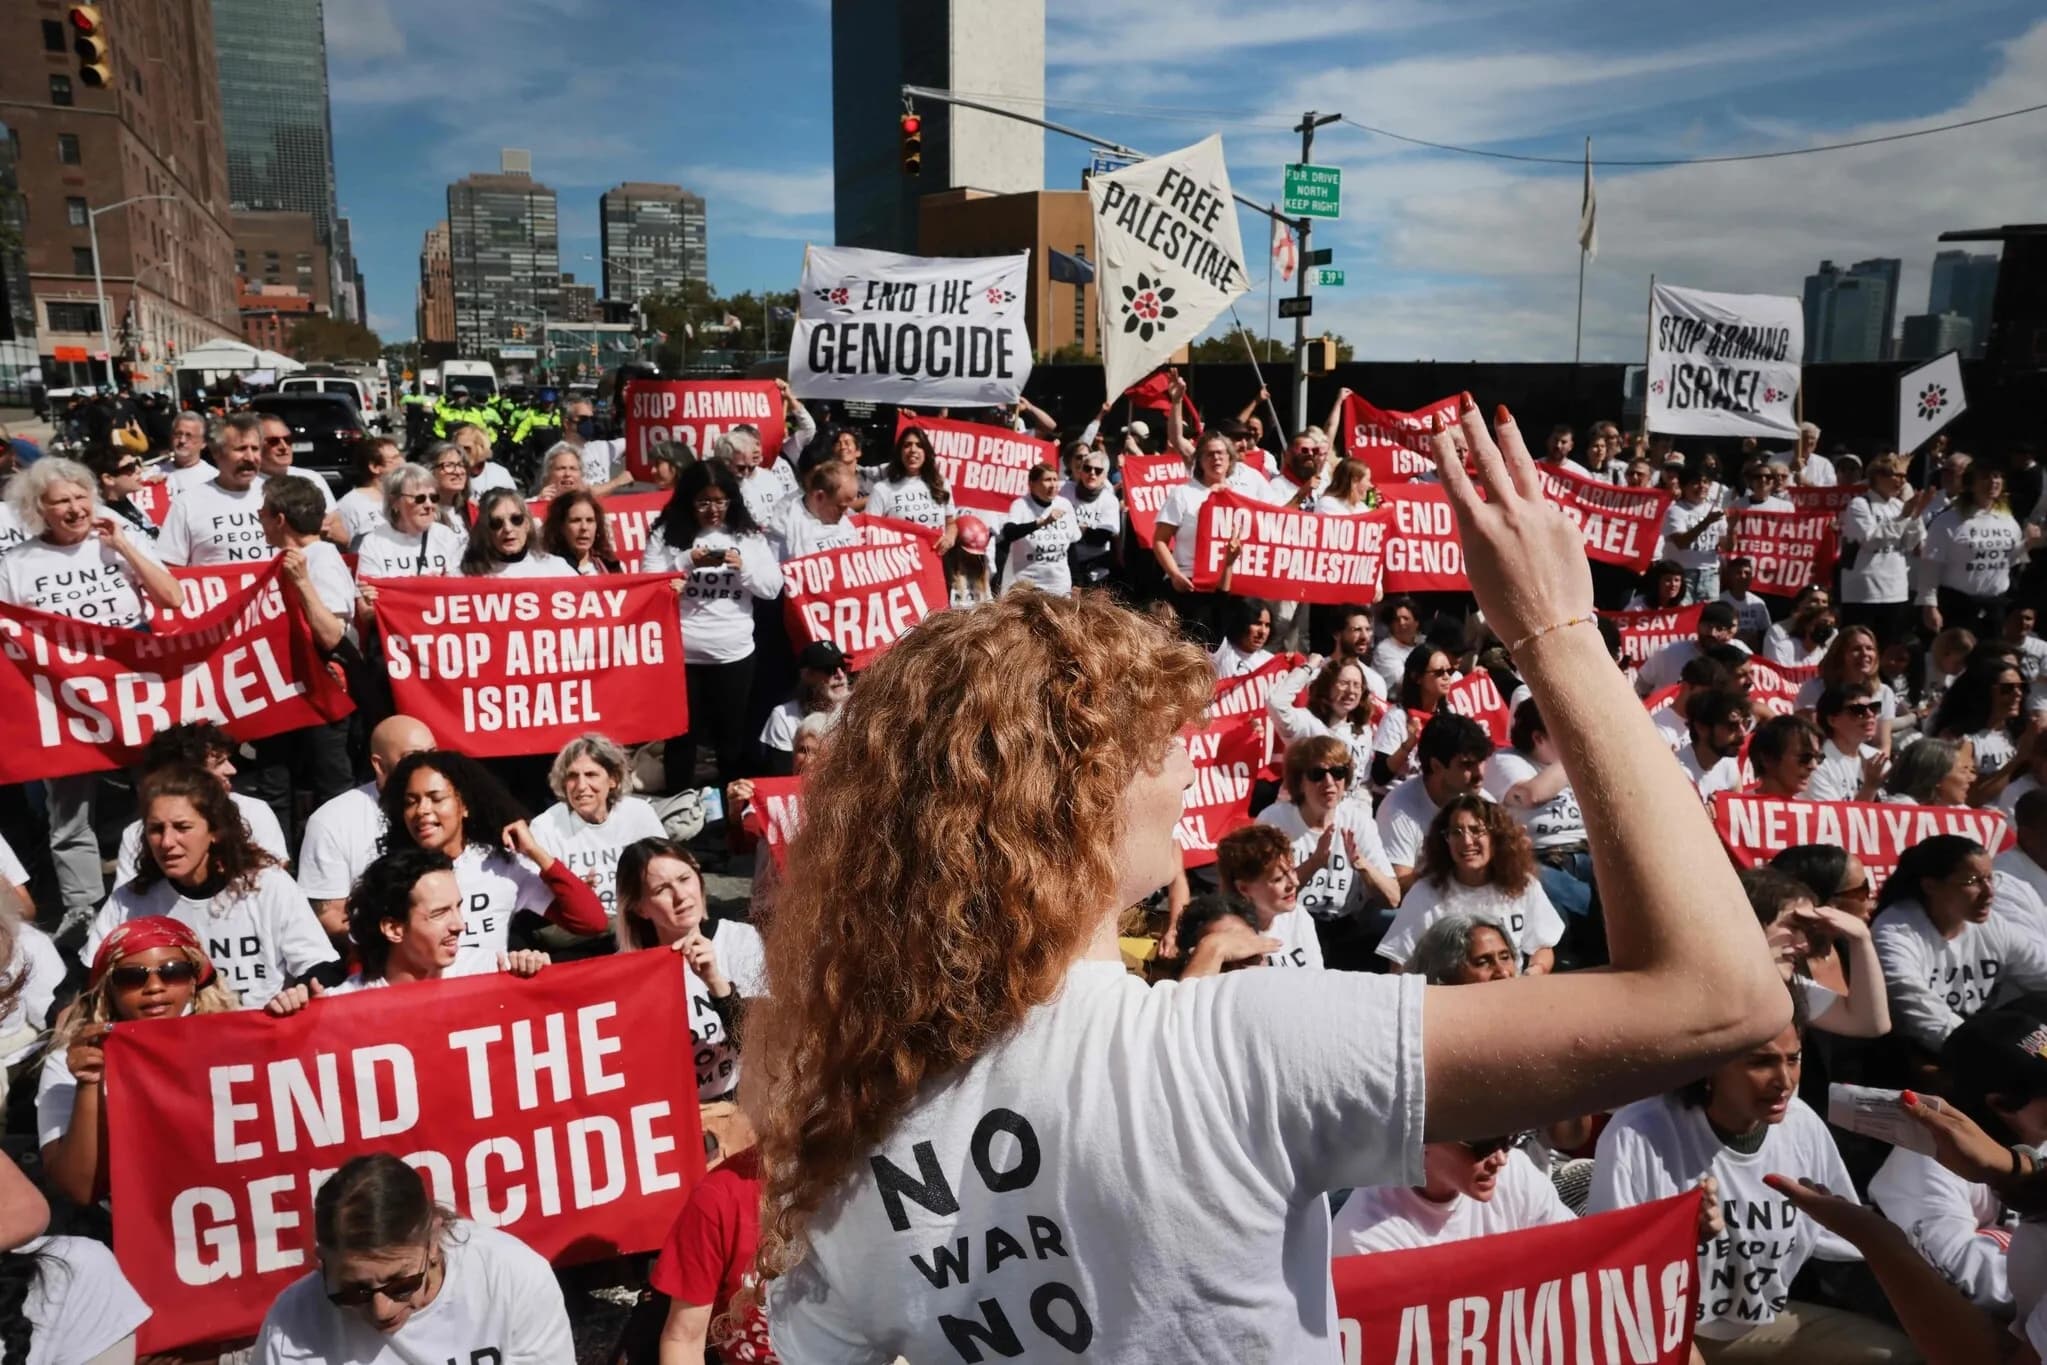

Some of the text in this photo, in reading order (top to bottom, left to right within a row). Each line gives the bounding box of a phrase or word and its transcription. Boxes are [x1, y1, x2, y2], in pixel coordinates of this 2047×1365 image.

[1297, 186, 1328, 198] NORTH
[1311, 172, 1338, 184] DRIVE
[1156, 167, 1225, 233] FREE
[1285, 198, 1338, 212] KEEP RIGHT
[1099, 180, 1240, 295] PALESTINE
[863, 279, 973, 315] END THE
[808, 322, 1013, 379] GENOCIDE
[1659, 315, 1790, 361] STOP ARMING
[1667, 363, 1761, 414] ISRAEL
[633, 391, 772, 419] STOP ARMING
[923, 429, 1044, 470] UND PEOPLE
[963, 461, 1031, 497] BOMB
[1144, 462, 1186, 482] JEW
[894, 492, 929, 505] FUN
[1539, 469, 1659, 520] TOP ARMING
[212, 512, 264, 529] FUN
[905, 513, 940, 524] NOT
[1039, 520, 1067, 531] UND
[1210, 506, 1386, 553] NO WAR NO ICE
[1396, 500, 1452, 535] END
[213, 530, 265, 545] PEOP
[1969, 527, 2012, 539] FUND
[228, 545, 279, 561] NOT
[384, 555, 447, 572] FUND
[1035, 544, 1066, 553] NOT
[1385, 537, 1467, 576] GENO
[1778, 542, 1816, 557] FOR
[1975, 550, 2012, 560] NOT
[35, 563, 120, 592] FUND
[688, 572, 736, 586] NOT
[783, 543, 923, 599] STOP ARMING
[1209, 542, 1379, 586] FREE PALESTINE
[35, 577, 126, 607] PEOPLE
[685, 588, 744, 601] OMBS
[53, 597, 117, 619] NOT
[422, 589, 629, 626] JEWS SAY
[802, 581, 929, 653] ISRAEL
[1635, 613, 1679, 632] SAY
[0, 617, 116, 666] STOP
[387, 621, 666, 681] STOP ARMING
[33, 636, 307, 747] ISRAEL
[462, 679, 602, 734] ISRAEL
[1184, 732, 1222, 760] AY
[1727, 797, 2009, 858] NETANYAHU
[568, 847, 623, 870] FUN
[1303, 895, 1334, 907] OT
[210, 1043, 419, 1164] END
[449, 1001, 625, 1119] THE
[870, 1108, 1041, 1231] NO
[171, 1100, 681, 1286] GEOCIDE
[1724, 1199, 1797, 1230] UND
[909, 1215, 1069, 1289] WAR
[1697, 1236, 1796, 1260] PEOPLE
[1711, 1265, 1778, 1295] NOT
[937, 1281, 1093, 1364] NO
[1394, 1258, 1690, 1365] ARMING
[1696, 1296, 1787, 1321] BOMS
